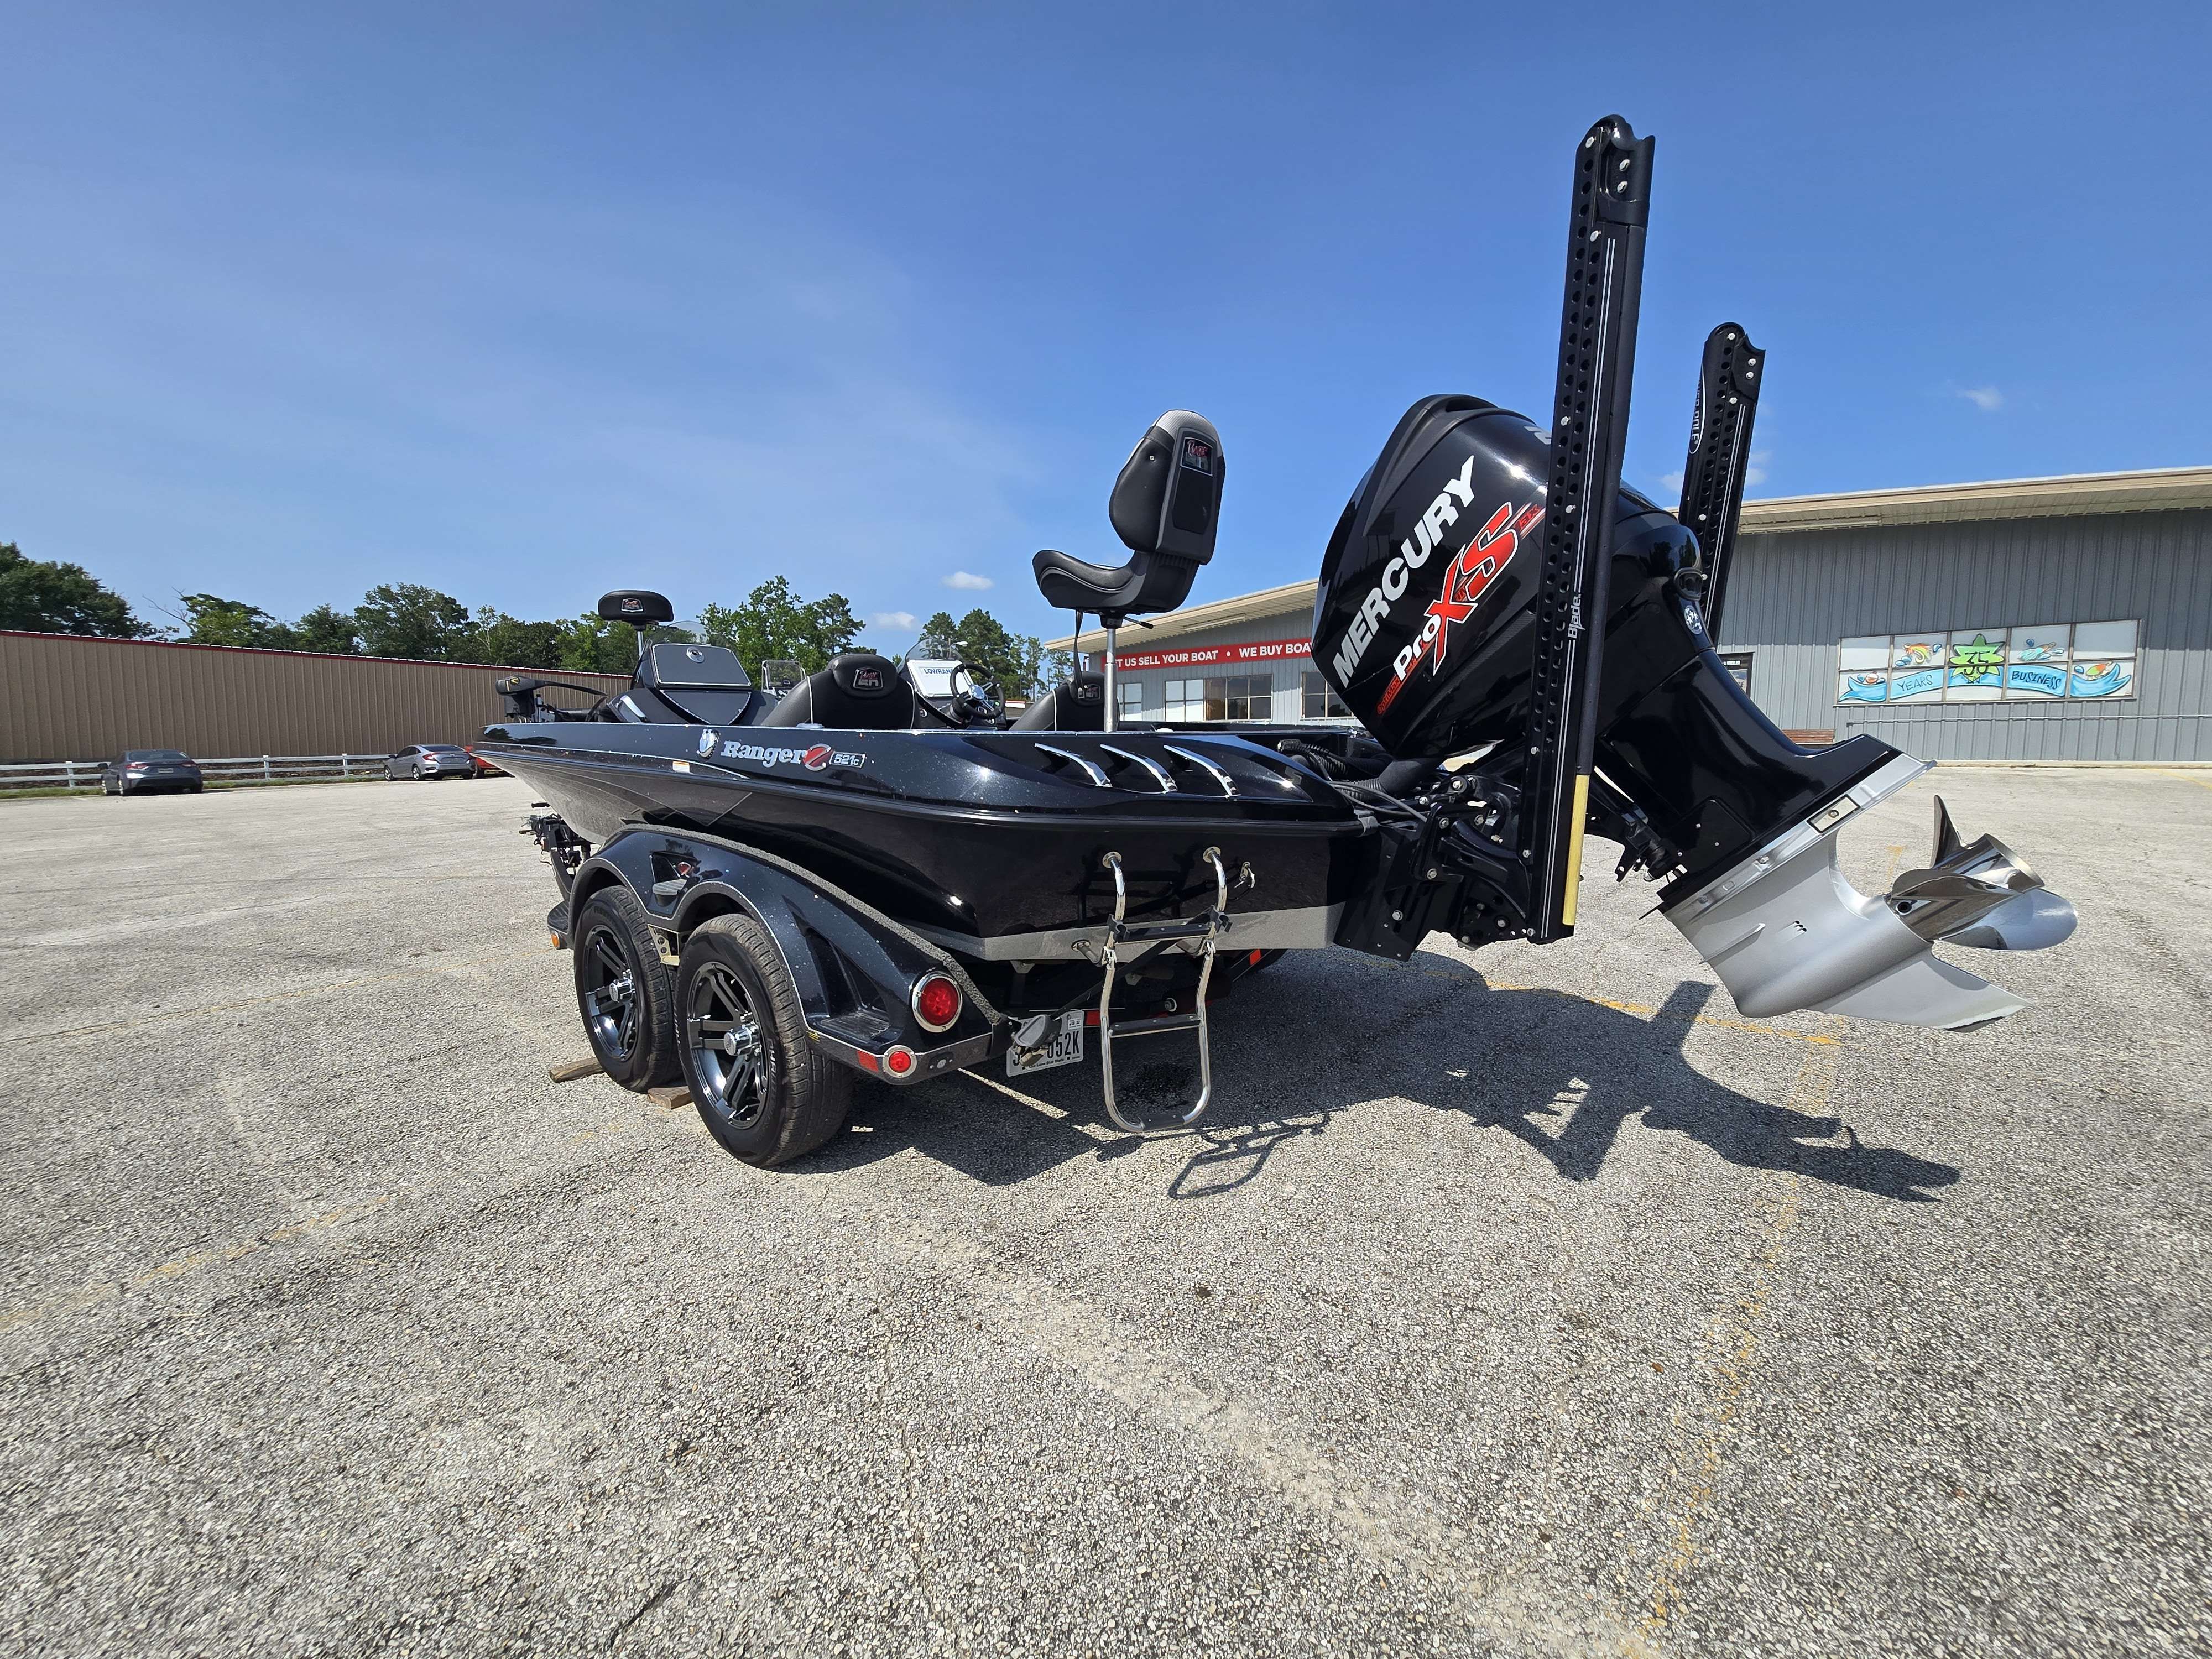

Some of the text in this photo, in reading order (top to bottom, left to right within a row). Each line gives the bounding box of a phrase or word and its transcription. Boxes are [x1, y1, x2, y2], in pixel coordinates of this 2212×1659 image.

[1333, 455, 1475, 688] MERCURY
[1124, 658, 1136, 667] US
[1138, 656, 1160, 666] SELL
[1162, 653, 1189, 664] YOUR
[1191, 650, 1218, 661] BOAT
[1239, 646, 1258, 658] WE
[1260, 645, 1283, 656] BUY
[1286, 642, 1313, 654] BOA
[1897, 674, 1933, 691] YEARS
[2011, 670, 2062, 690] BUSINESS
[721, 740, 808, 768] Ranger
